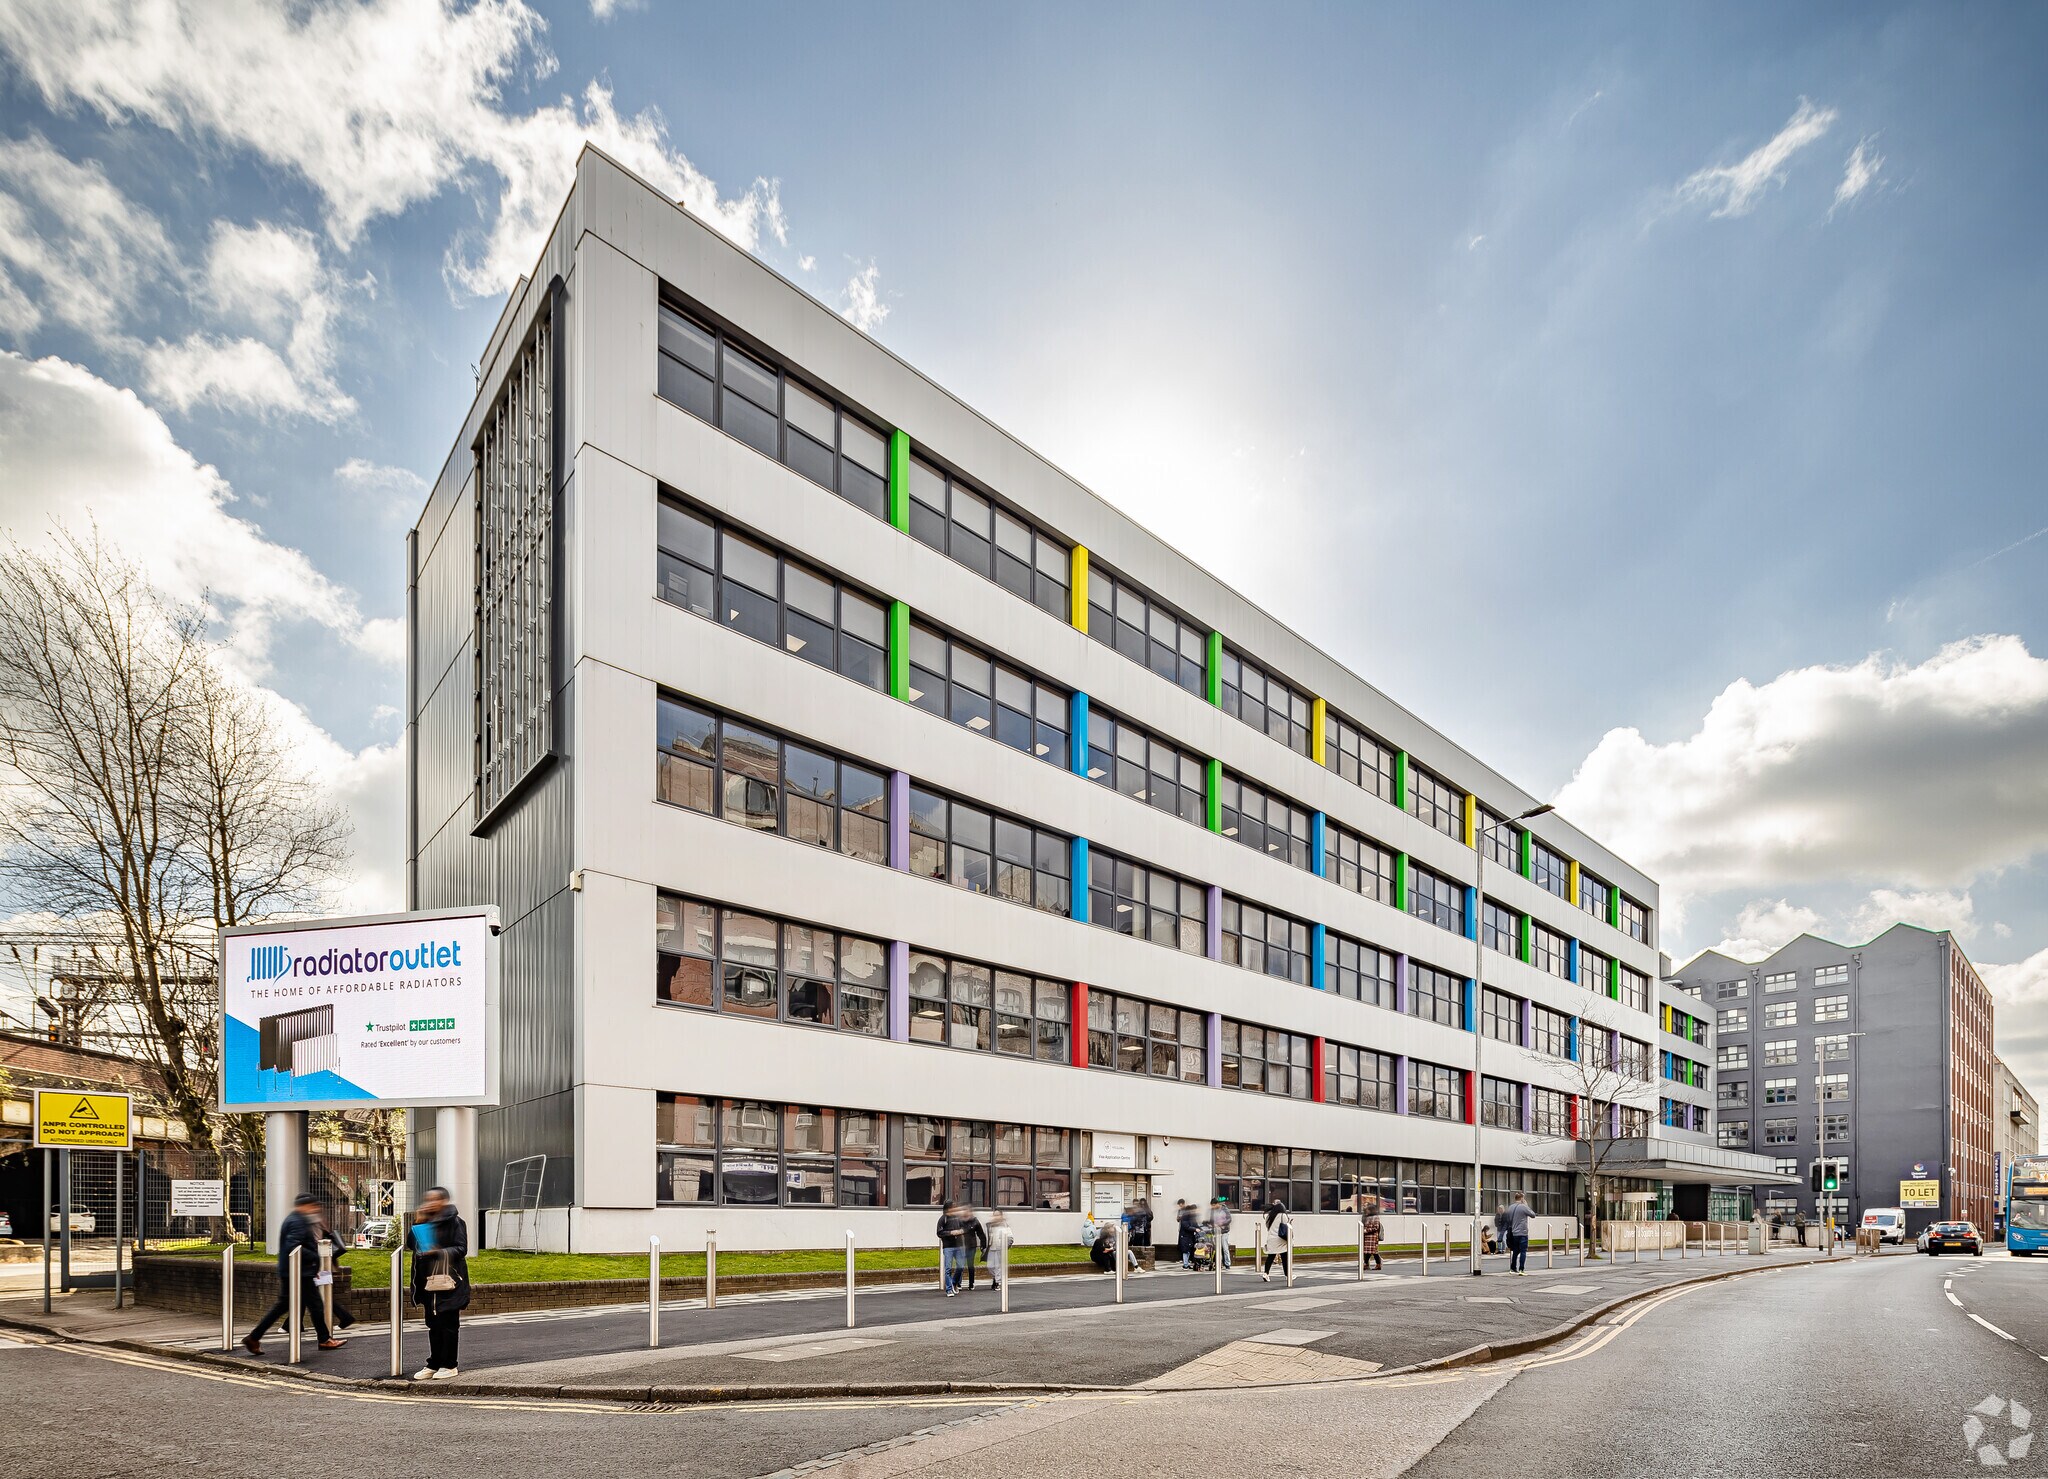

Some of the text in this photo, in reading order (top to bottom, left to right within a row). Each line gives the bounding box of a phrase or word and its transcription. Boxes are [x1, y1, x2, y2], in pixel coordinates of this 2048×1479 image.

[293, 940, 462, 978] radiatoroutlet
[251, 977, 462, 999] THE HOME OF AFFORDABLE RADIATORS
[375, 1023, 406, 1033] Trustpilot
[410, 1039, 417, 1047] by
[430, 1037, 461, 1045] customers
[69, 1122, 125, 1130] CONTROLLED
[79, 1130, 125, 1138] APPROACH
[1903, 1188, 1936, 1197] TO LET
